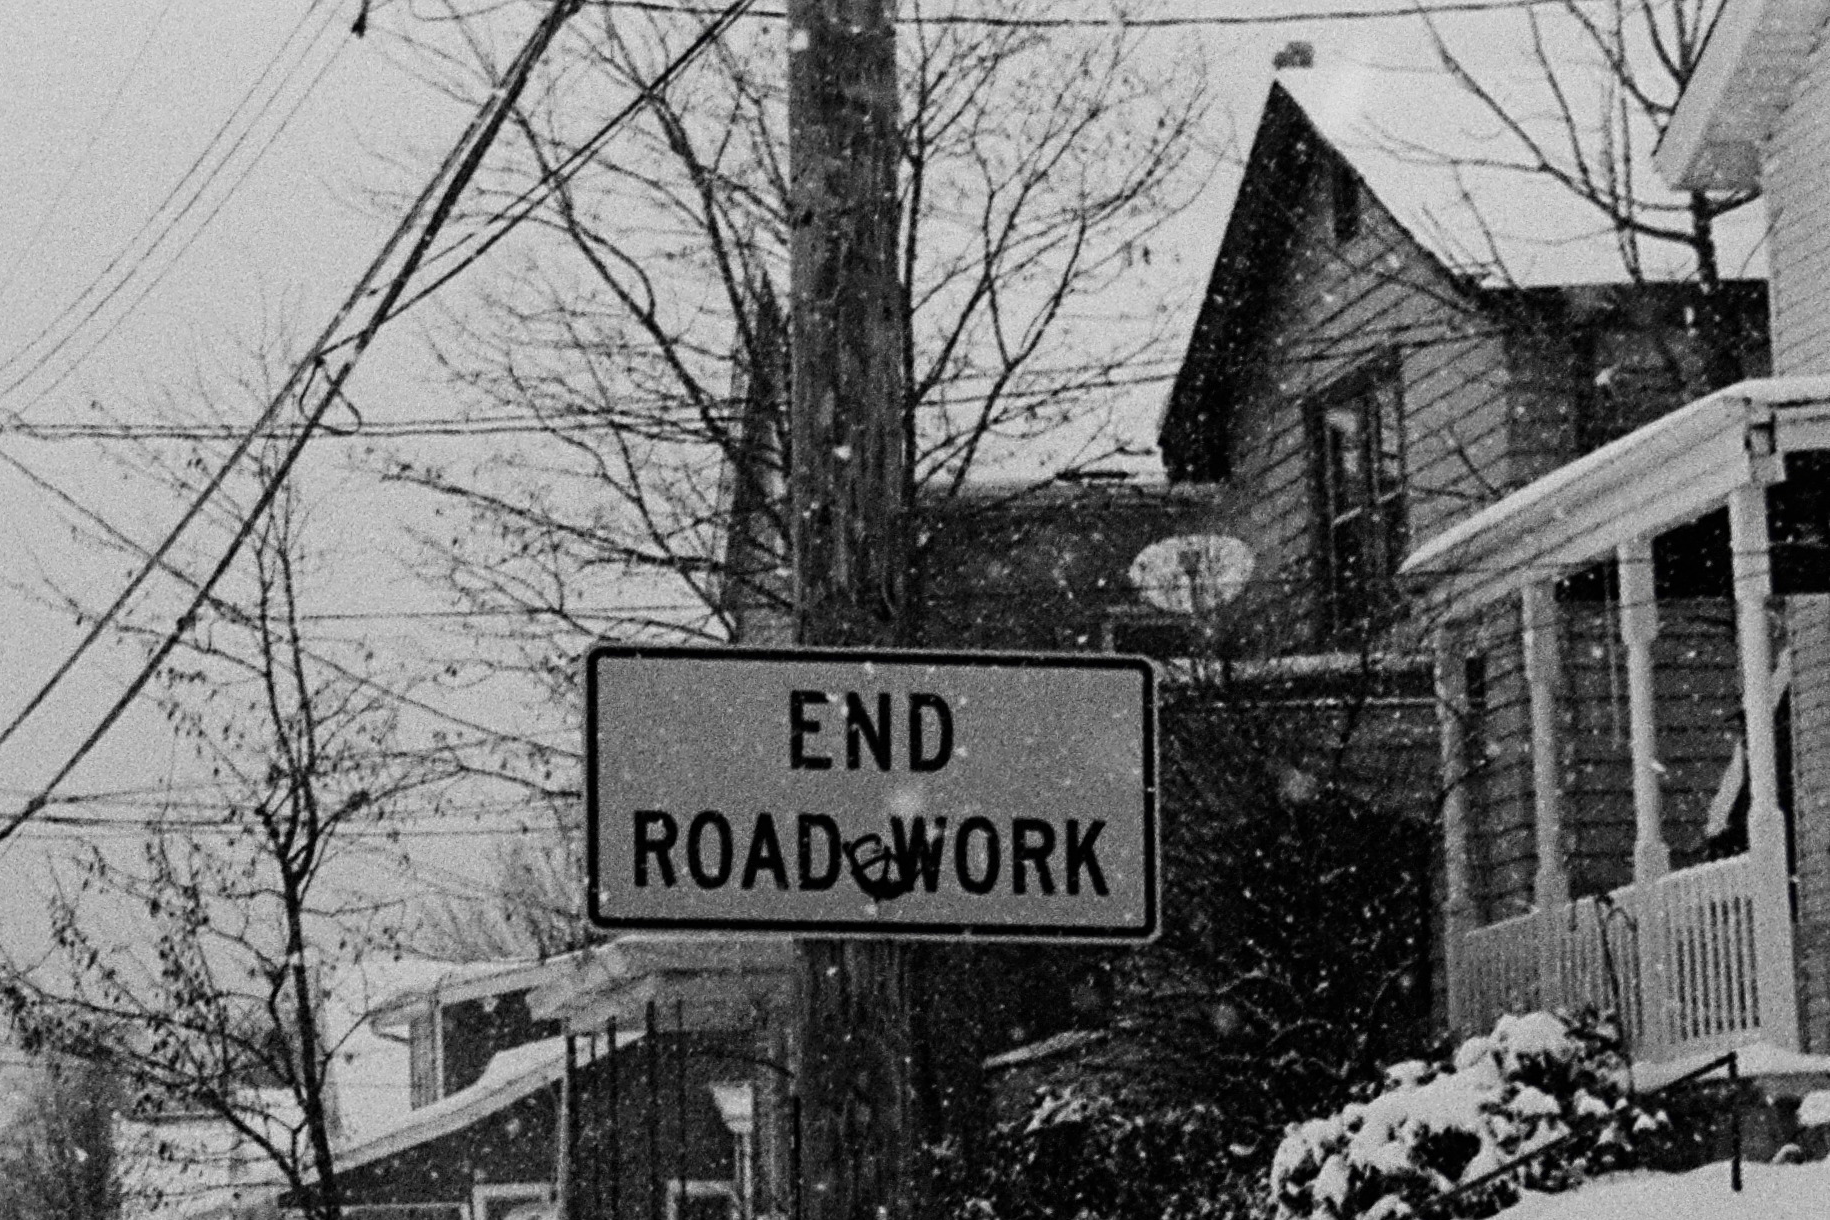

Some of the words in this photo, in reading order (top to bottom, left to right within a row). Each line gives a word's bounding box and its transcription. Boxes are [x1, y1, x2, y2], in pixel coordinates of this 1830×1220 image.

[789, 689, 954, 773] END
[633, 809, 843, 892] ROAD
[888, 815, 1110, 897] WORK
